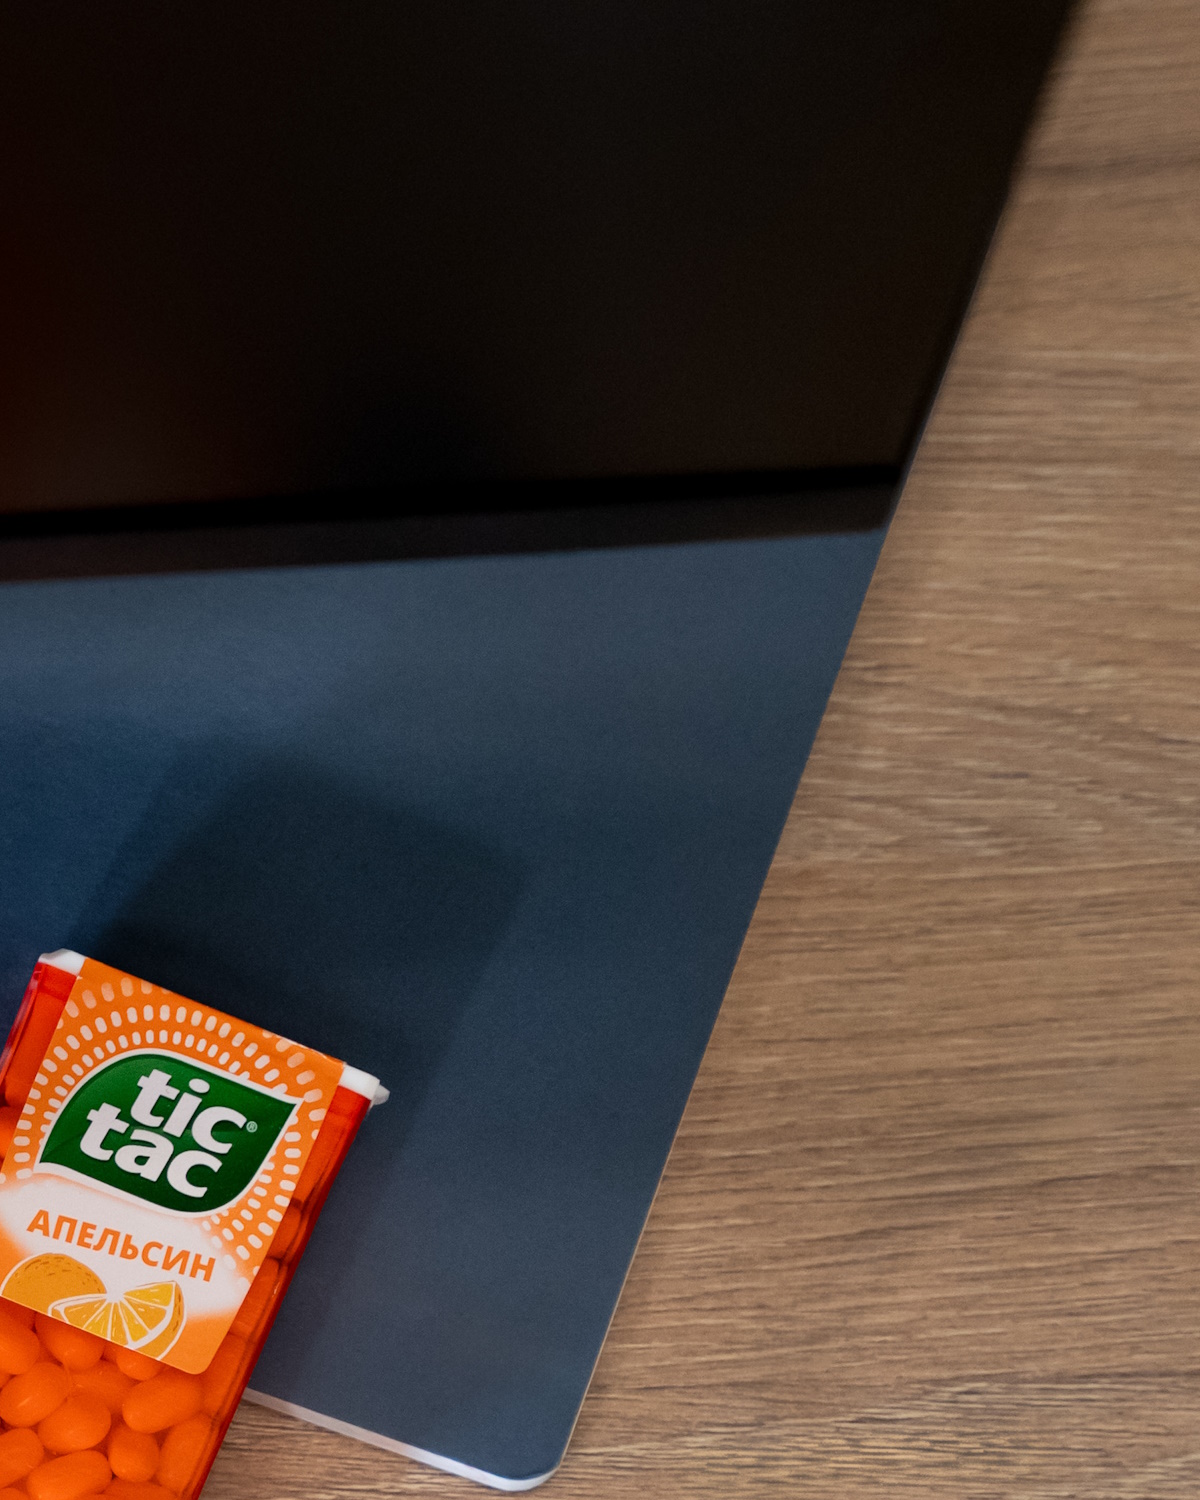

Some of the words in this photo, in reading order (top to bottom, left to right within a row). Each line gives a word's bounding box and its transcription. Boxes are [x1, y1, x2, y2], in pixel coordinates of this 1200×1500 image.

[79, 1102, 223, 1198] tac
[129, 1068, 248, 1155] tic
[26, 1208, 216, 1283] АПЕЛЬСИН
